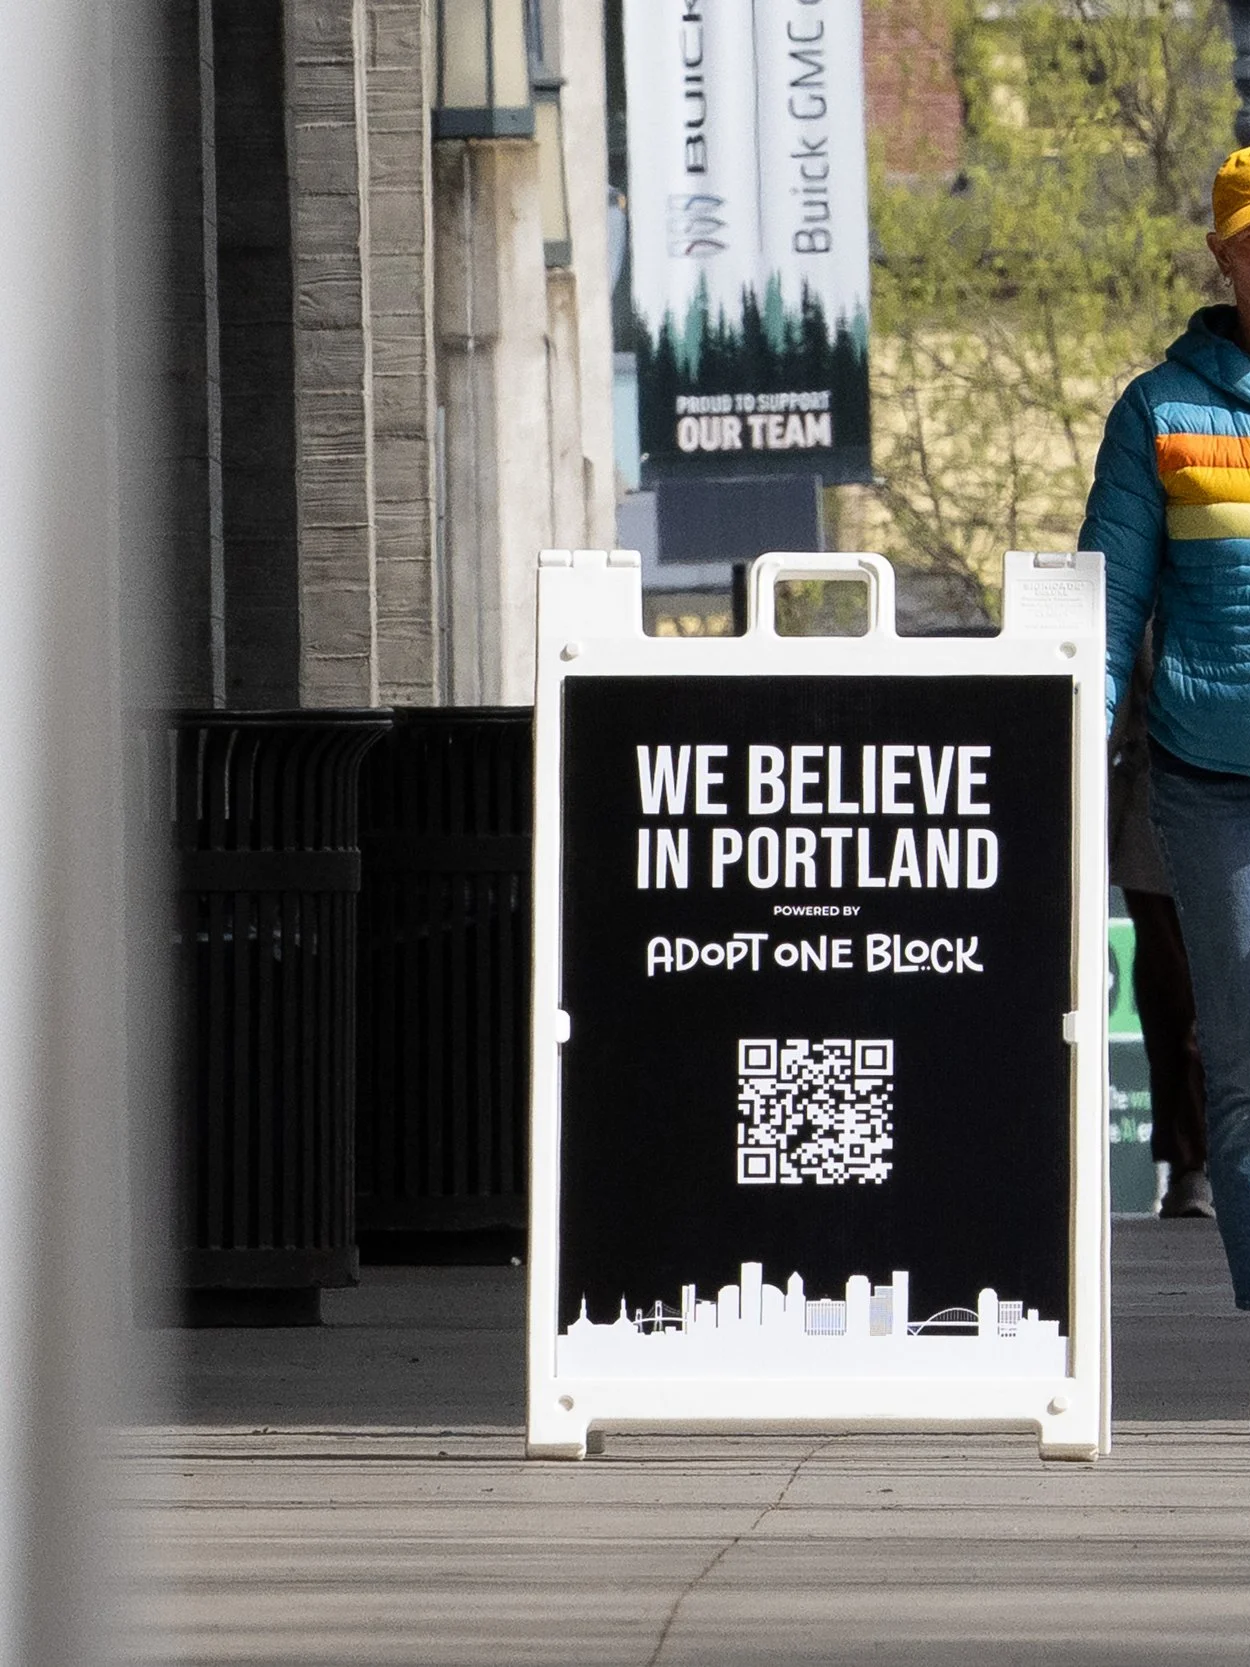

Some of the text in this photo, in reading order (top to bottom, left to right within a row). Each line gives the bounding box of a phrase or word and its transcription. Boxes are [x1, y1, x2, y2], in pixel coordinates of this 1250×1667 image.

[787, 20, 827, 120] GMC
[790, 136, 832, 254] Buick
[676, 390, 831, 414] PROUD TO SUPPORT
[677, 411, 832, 452] OUR TEAM
[637, 745, 991, 814] WE BELIEVE
[637, 827, 998, 889] IN PORTLAND
[773, 905, 860, 917] POWERED BY
